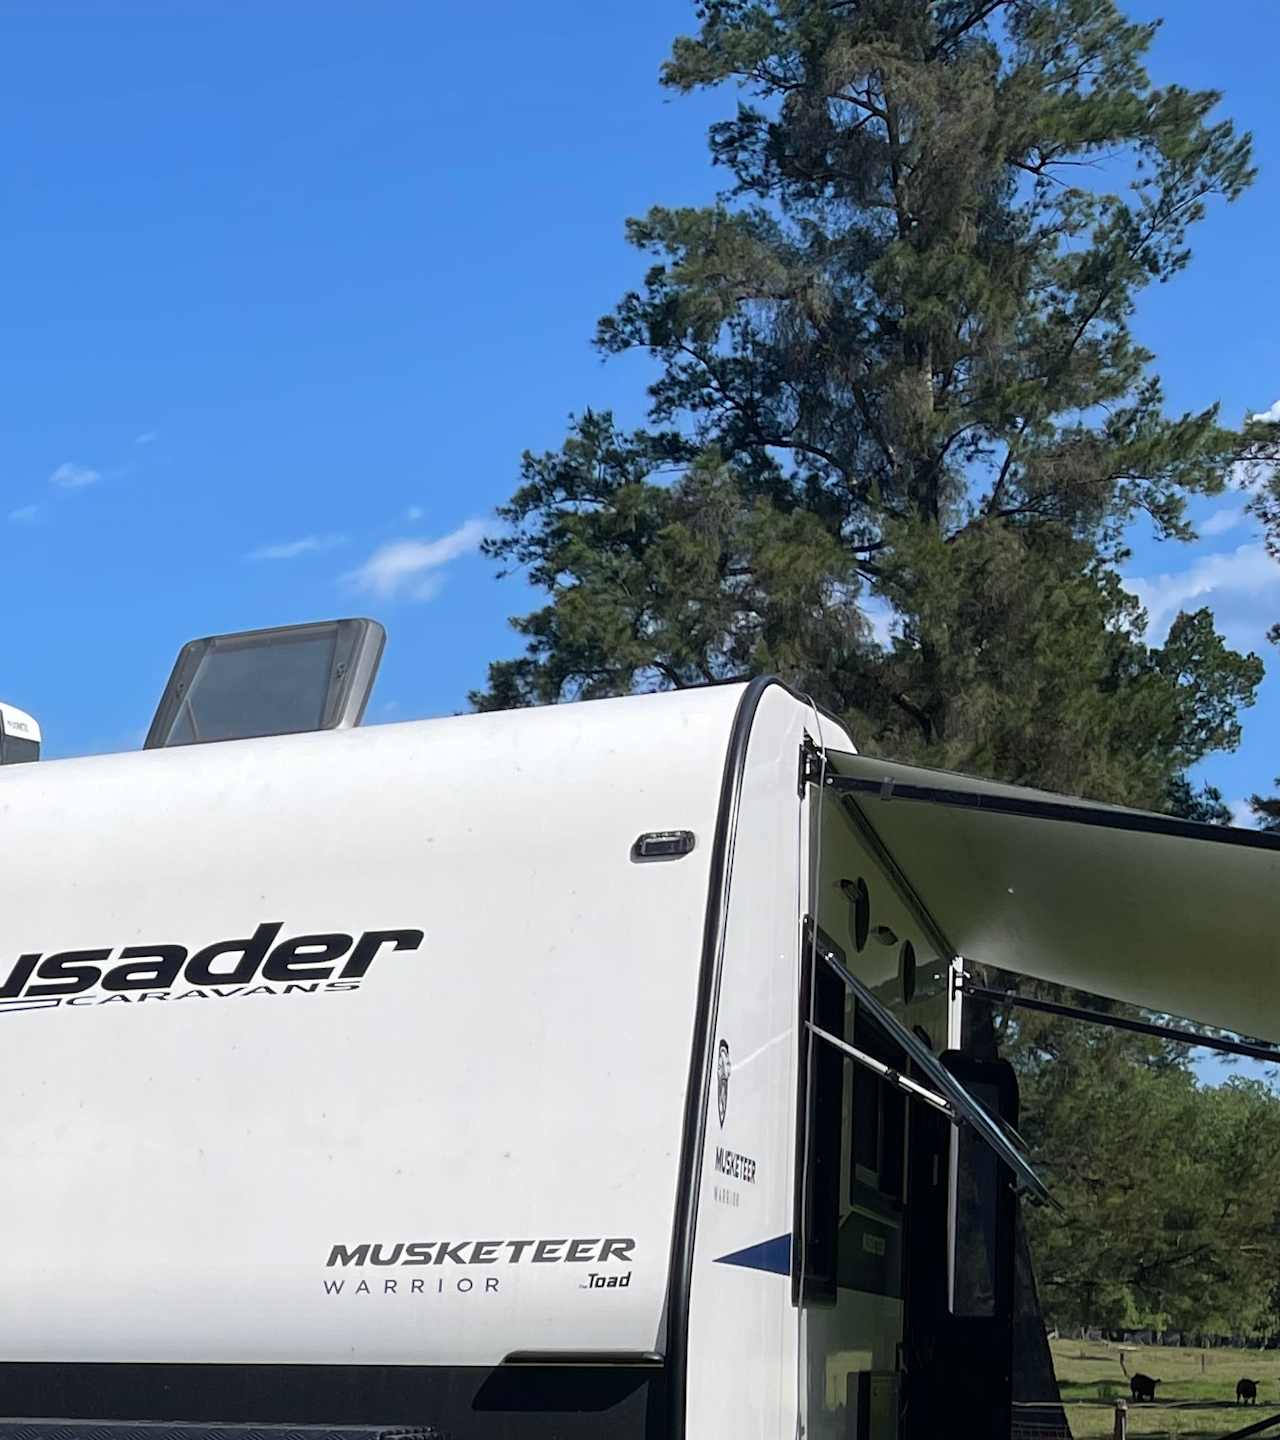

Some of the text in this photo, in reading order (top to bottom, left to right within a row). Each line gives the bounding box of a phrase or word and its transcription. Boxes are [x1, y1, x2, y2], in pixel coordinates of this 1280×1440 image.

[65, 980, 362, 1007] CARAVANS
[326, 1237, 636, 1267] MUSKETEER
[323, 1277, 501, 1295] WARRIOR
[587, 1270, 632, 1289] Toad
